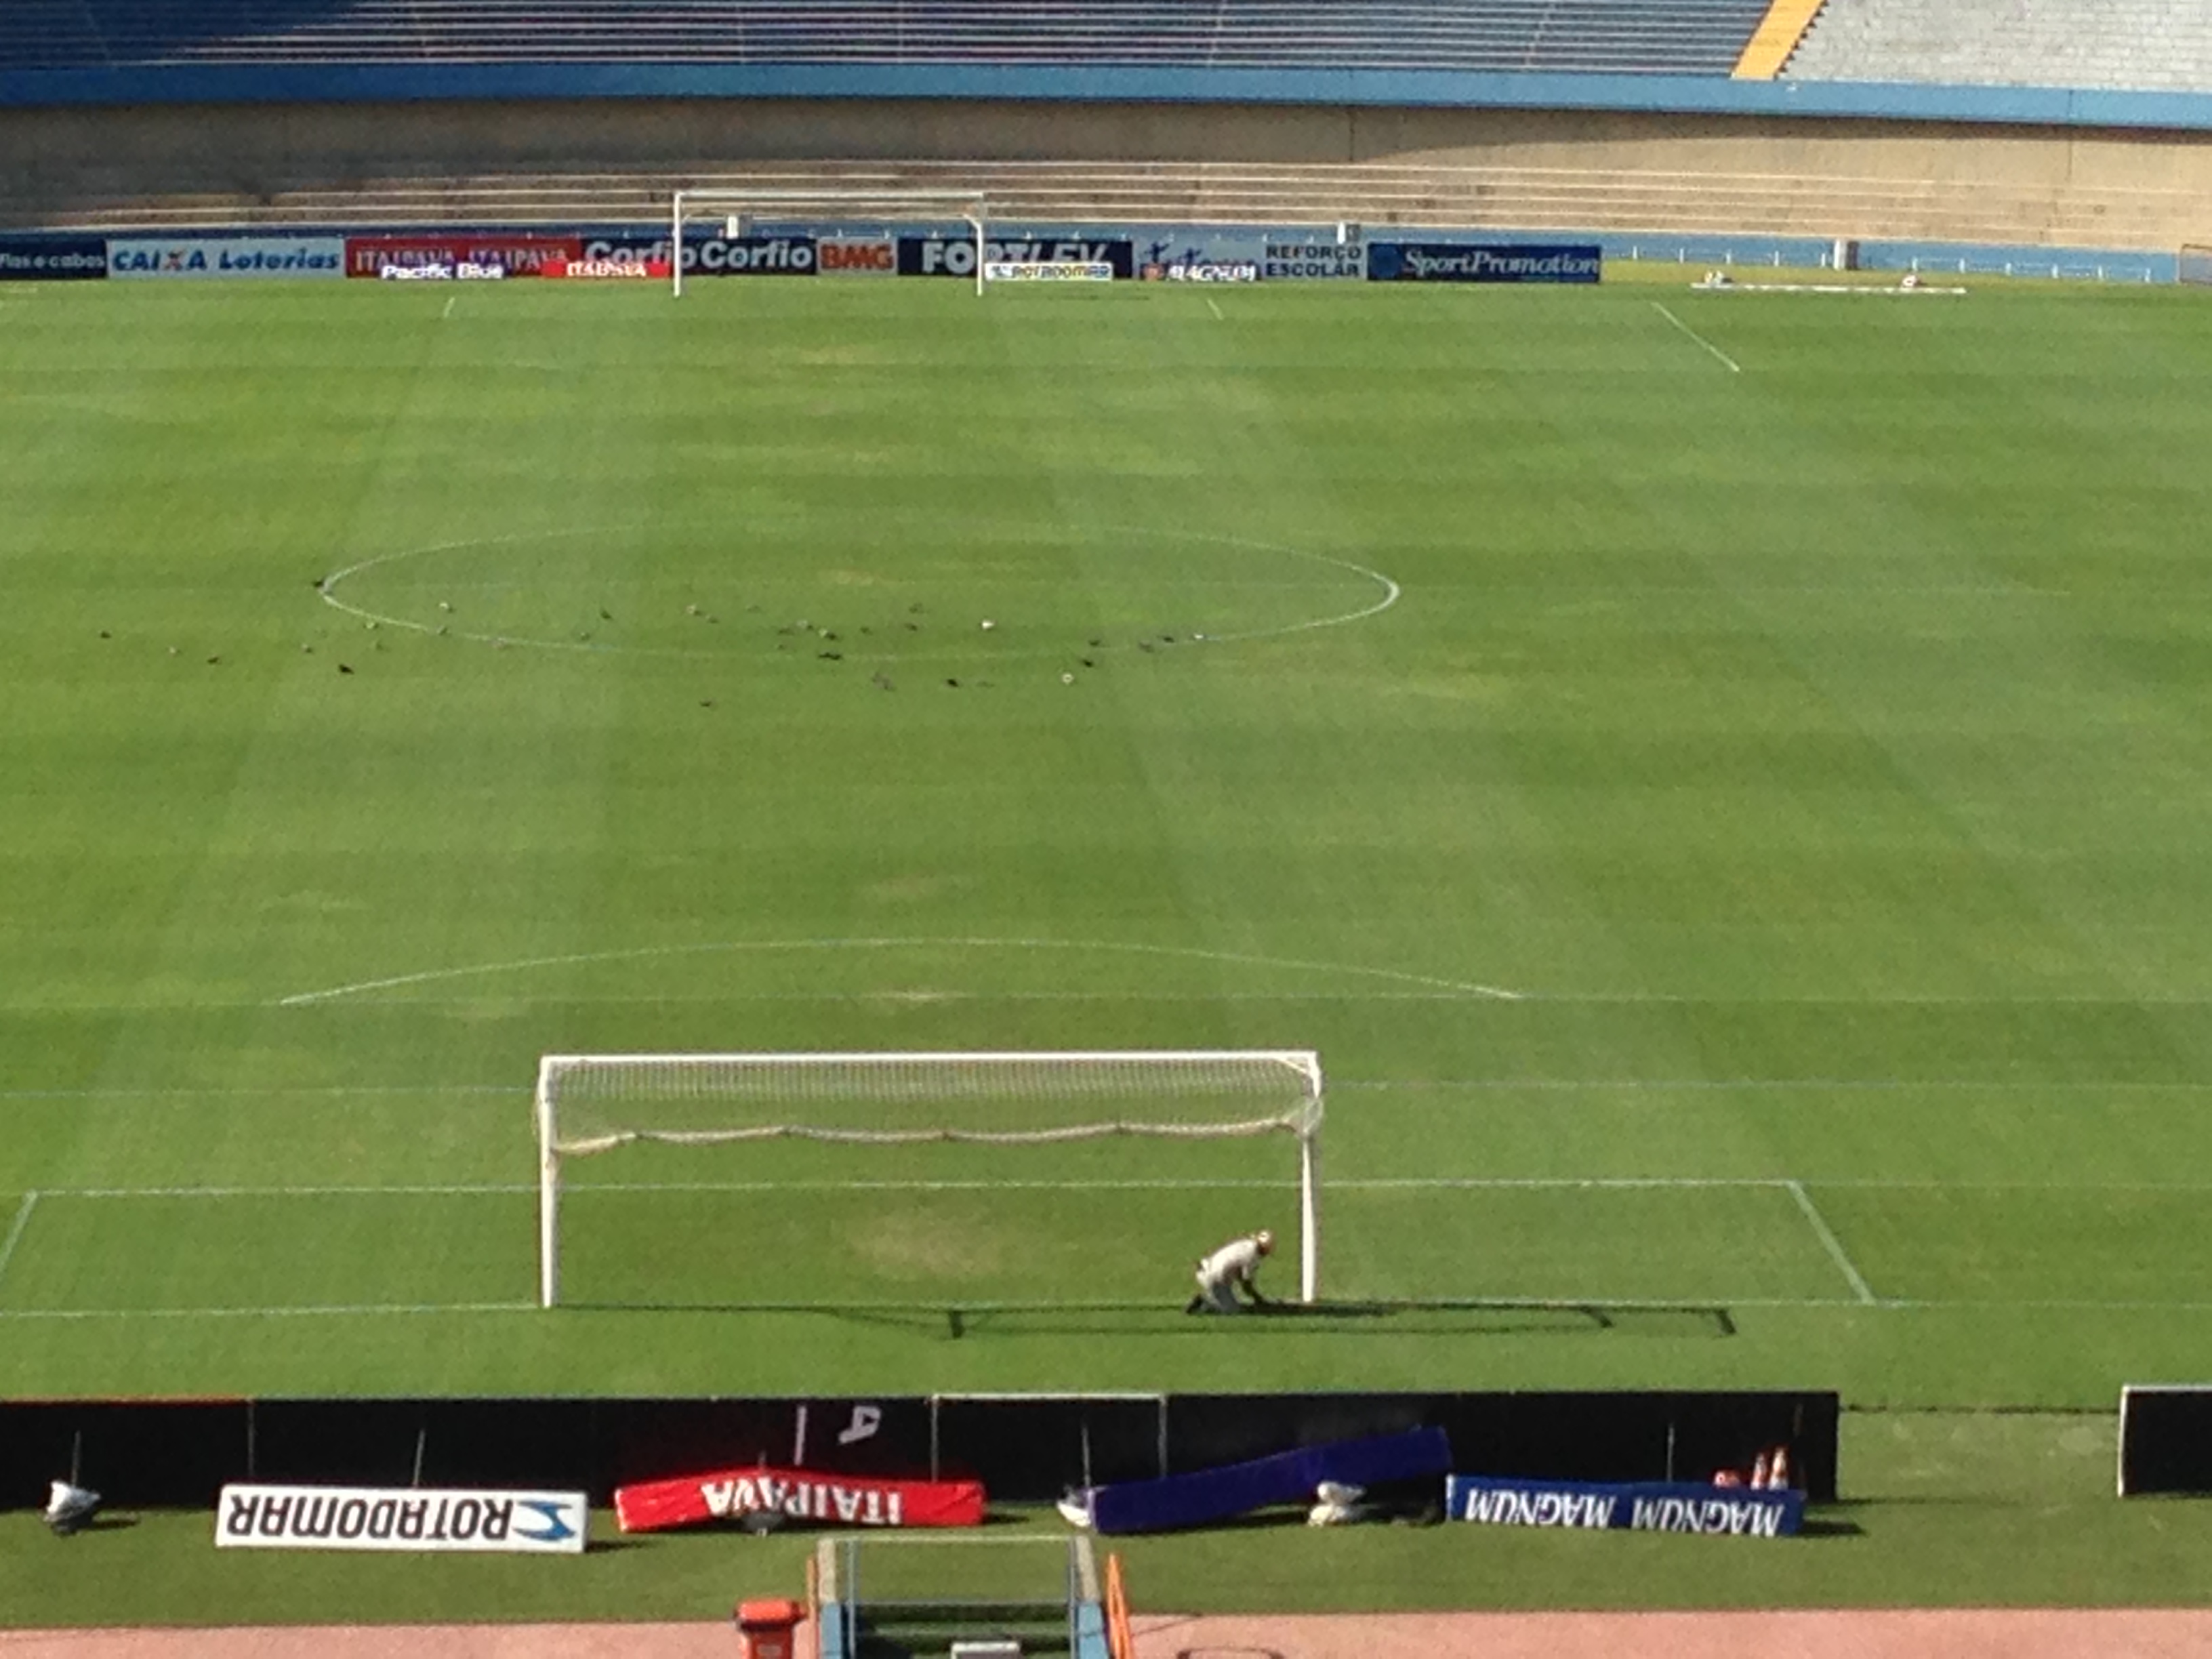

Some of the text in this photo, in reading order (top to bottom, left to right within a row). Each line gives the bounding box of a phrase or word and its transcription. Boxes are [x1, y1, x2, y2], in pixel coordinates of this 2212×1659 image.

[113, 247, 338, 271] CAIXA Loterias
[701, 241, 813, 268] Corfio
[821, 244, 895, 268] BMG
[1265, 245, 1361, 262] REFORÇO
[1266, 263, 1359, 277] ESCOLAR
[701, 1476, 902, 1524] ITAIPAVA
[1465, 1488, 1784, 1537] MAGNUM MAGNUM
[227, 1494, 514, 1540] ROTADOMAR
